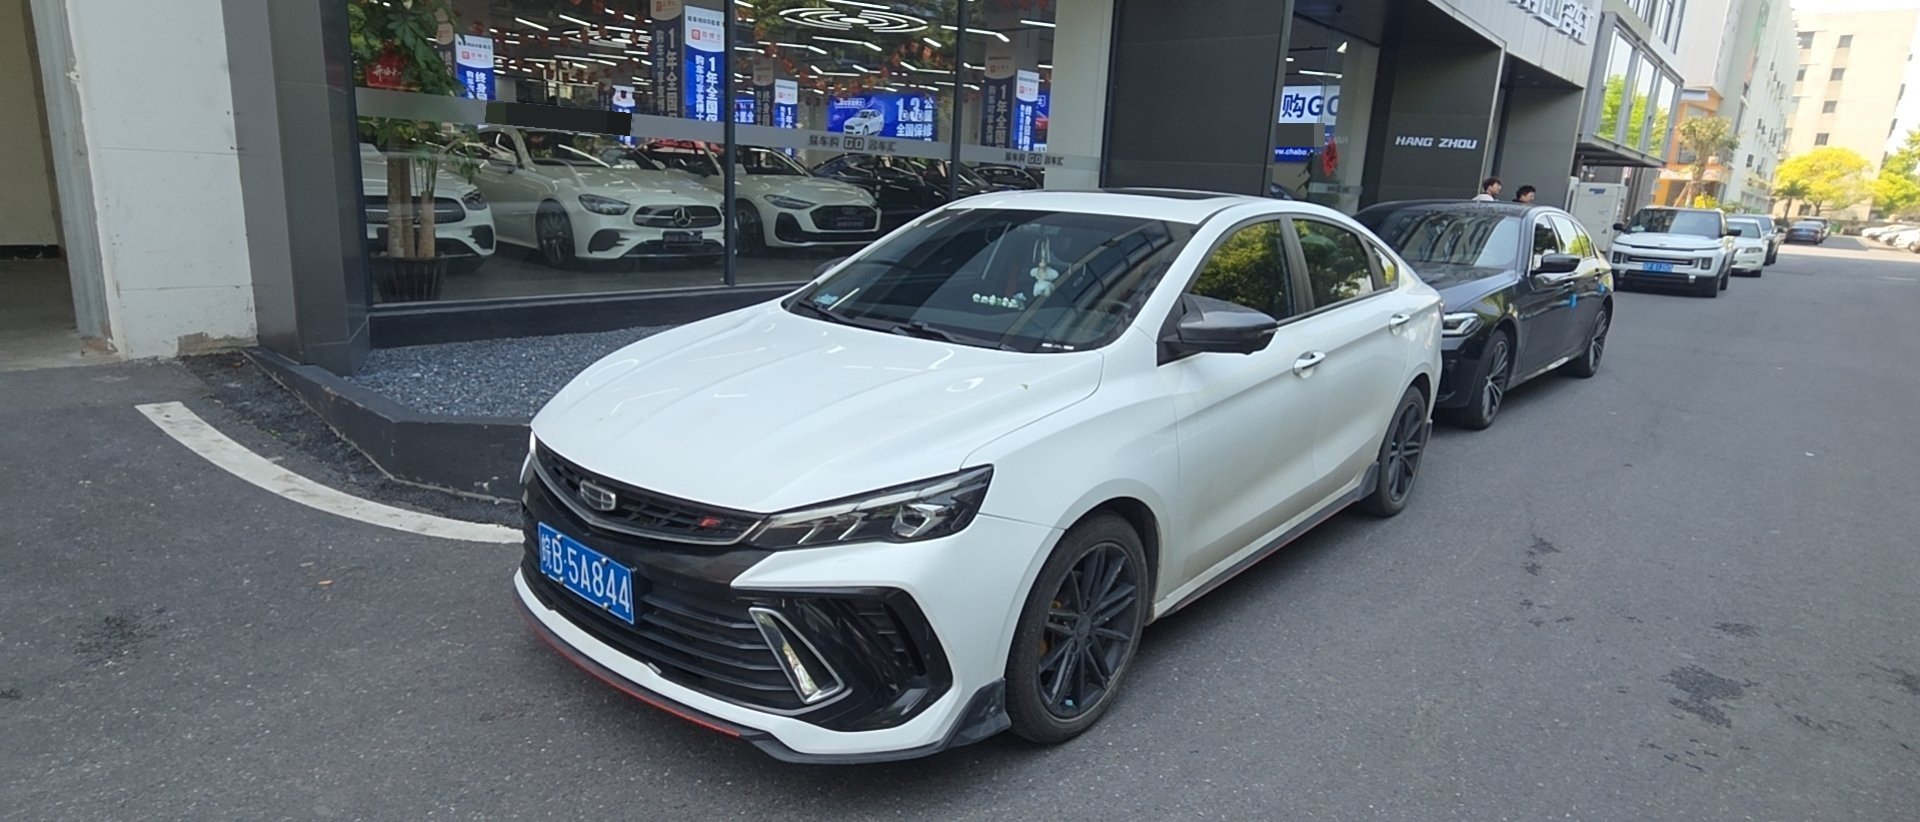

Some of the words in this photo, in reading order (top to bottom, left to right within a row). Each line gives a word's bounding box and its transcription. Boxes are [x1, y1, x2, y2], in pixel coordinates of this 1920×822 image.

[665, 28, 678, 118] 1年全国
[994, 84, 1008, 148] 1年全国
[1395, 135, 1434, 147] HANG
[1438, 138, 1477, 149] ZHOU
[541, 533, 630, 614] 皖B·5A844
